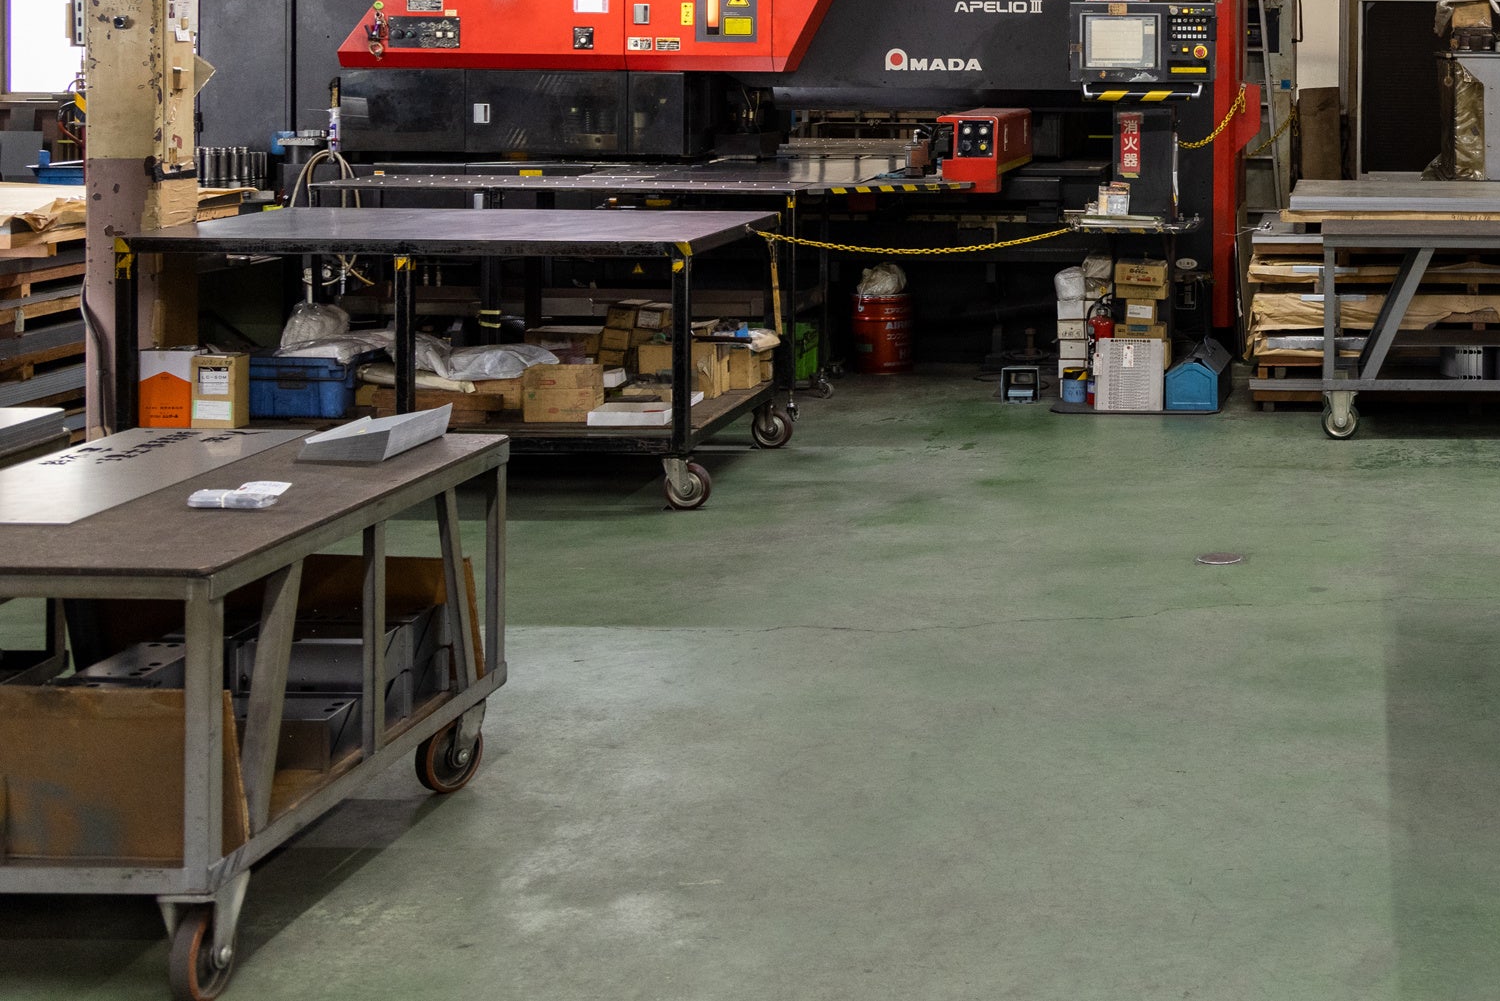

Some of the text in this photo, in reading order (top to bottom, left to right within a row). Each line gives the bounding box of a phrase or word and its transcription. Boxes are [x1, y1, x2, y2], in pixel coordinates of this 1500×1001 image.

[954, 0, 1027, 14] APELIO
[885, 47, 983, 72] AMADA
[1123, 119, 1139, 167] 消火器
